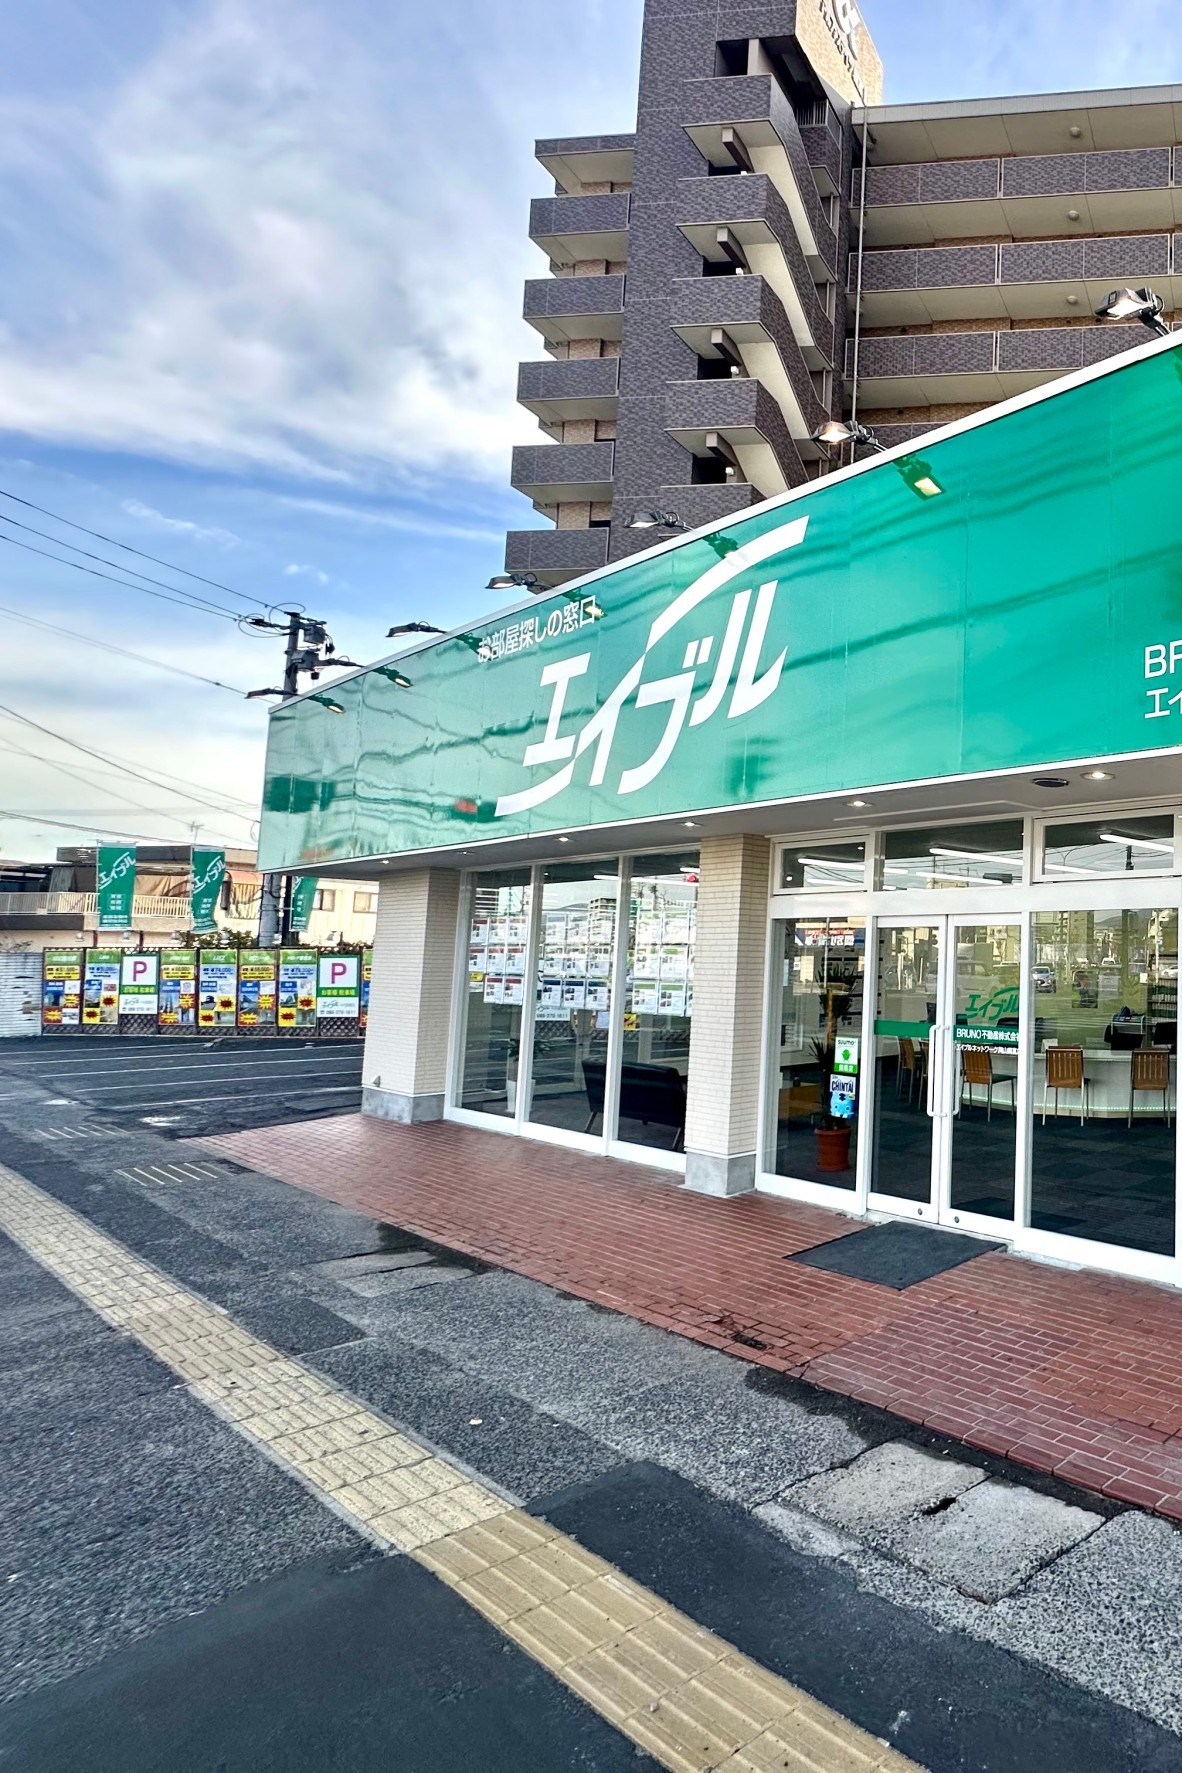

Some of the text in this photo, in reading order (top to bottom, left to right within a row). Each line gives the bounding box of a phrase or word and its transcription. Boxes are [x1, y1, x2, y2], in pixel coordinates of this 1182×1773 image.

[478, 595, 596, 663] お部屋探しの窓口
[494, 514, 810, 817] エイブル
[133, 961, 147, 982] P
[331, 962, 347, 984] P
[957, 987, 1019, 1020] エイブル
[956, 1028, 1019, 1042] BRUNO不動産株式会
[832, 1079, 853, 1093] CHINTAI
